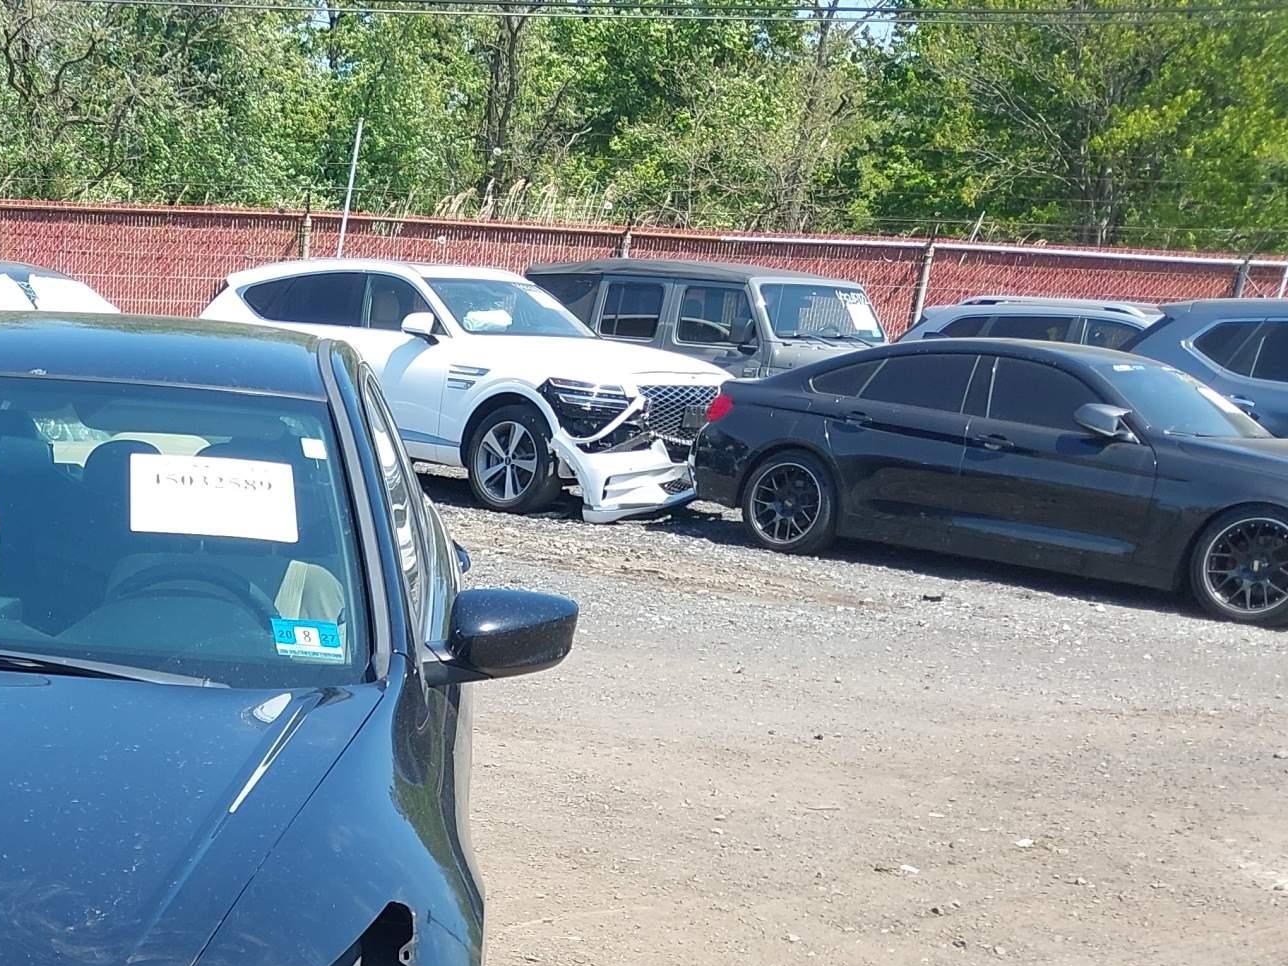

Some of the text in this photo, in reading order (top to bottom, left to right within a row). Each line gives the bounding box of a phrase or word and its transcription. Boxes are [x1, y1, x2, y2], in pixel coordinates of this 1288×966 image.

[278, 629, 337, 643] 20 8 27
